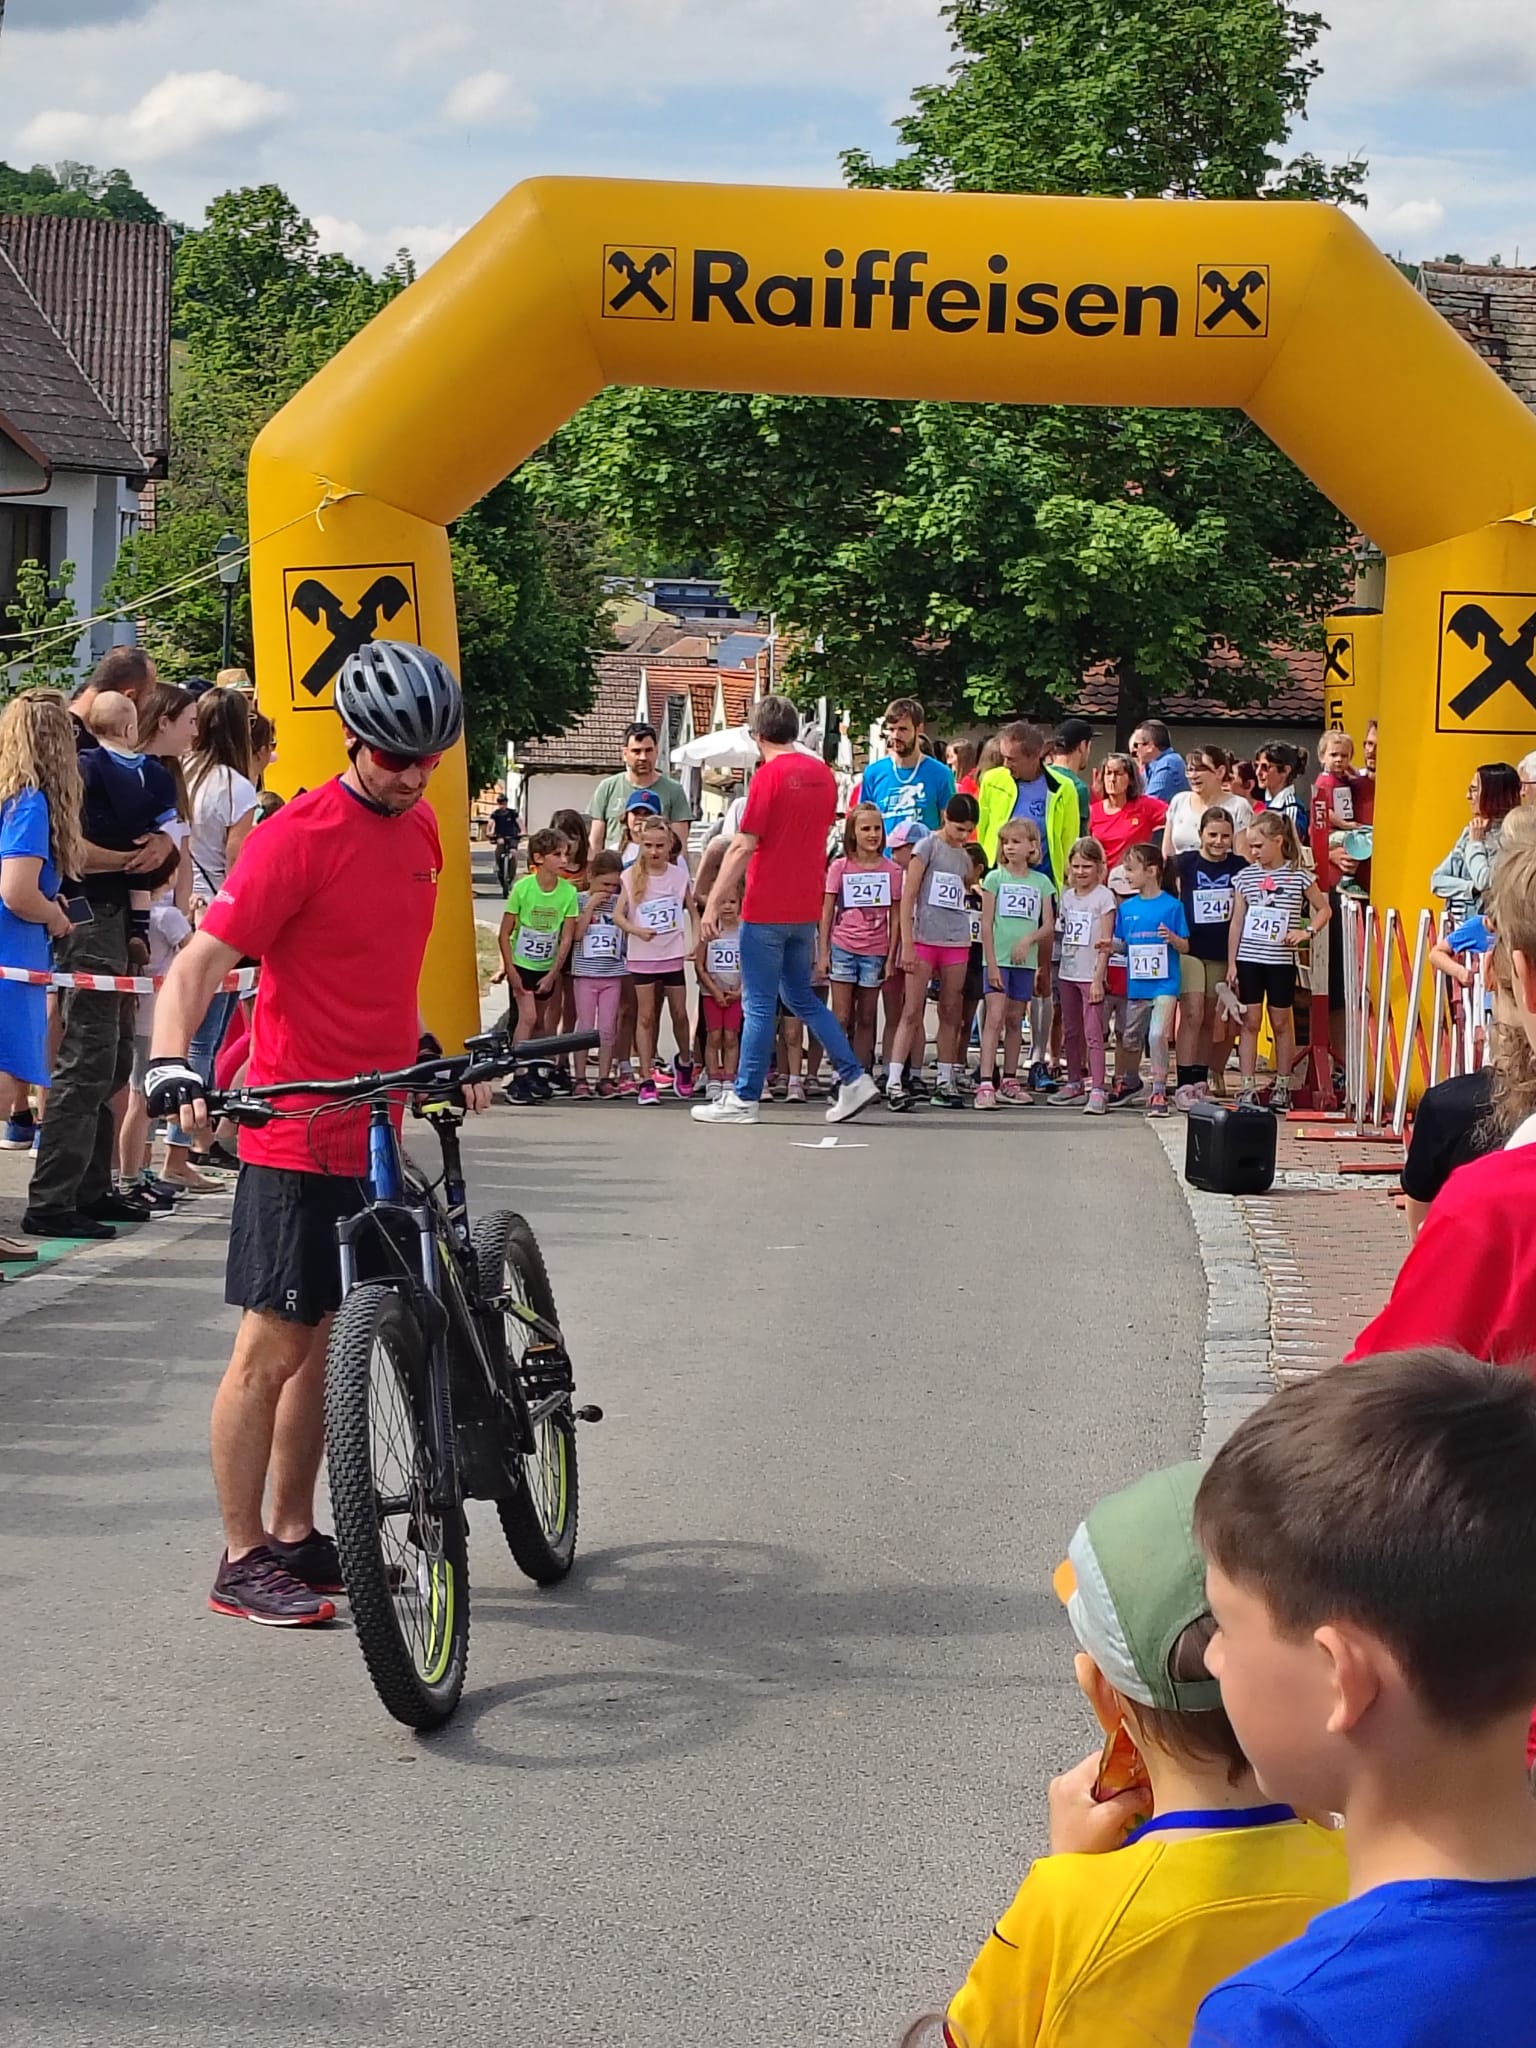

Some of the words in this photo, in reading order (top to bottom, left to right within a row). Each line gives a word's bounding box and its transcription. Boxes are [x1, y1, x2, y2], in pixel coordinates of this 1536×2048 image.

[692, 249, 1178, 337] Raiffeisen
[852, 884, 883, 898] 247
[938, 885, 961, 900] 20
[1202, 900, 1230, 914] 244
[648, 908, 676, 925] 237
[1251, 918, 1281, 933] 245
[524, 940, 553, 954] 255
[591, 935, 617, 949] 254
[1134, 957, 1160, 970] 213
